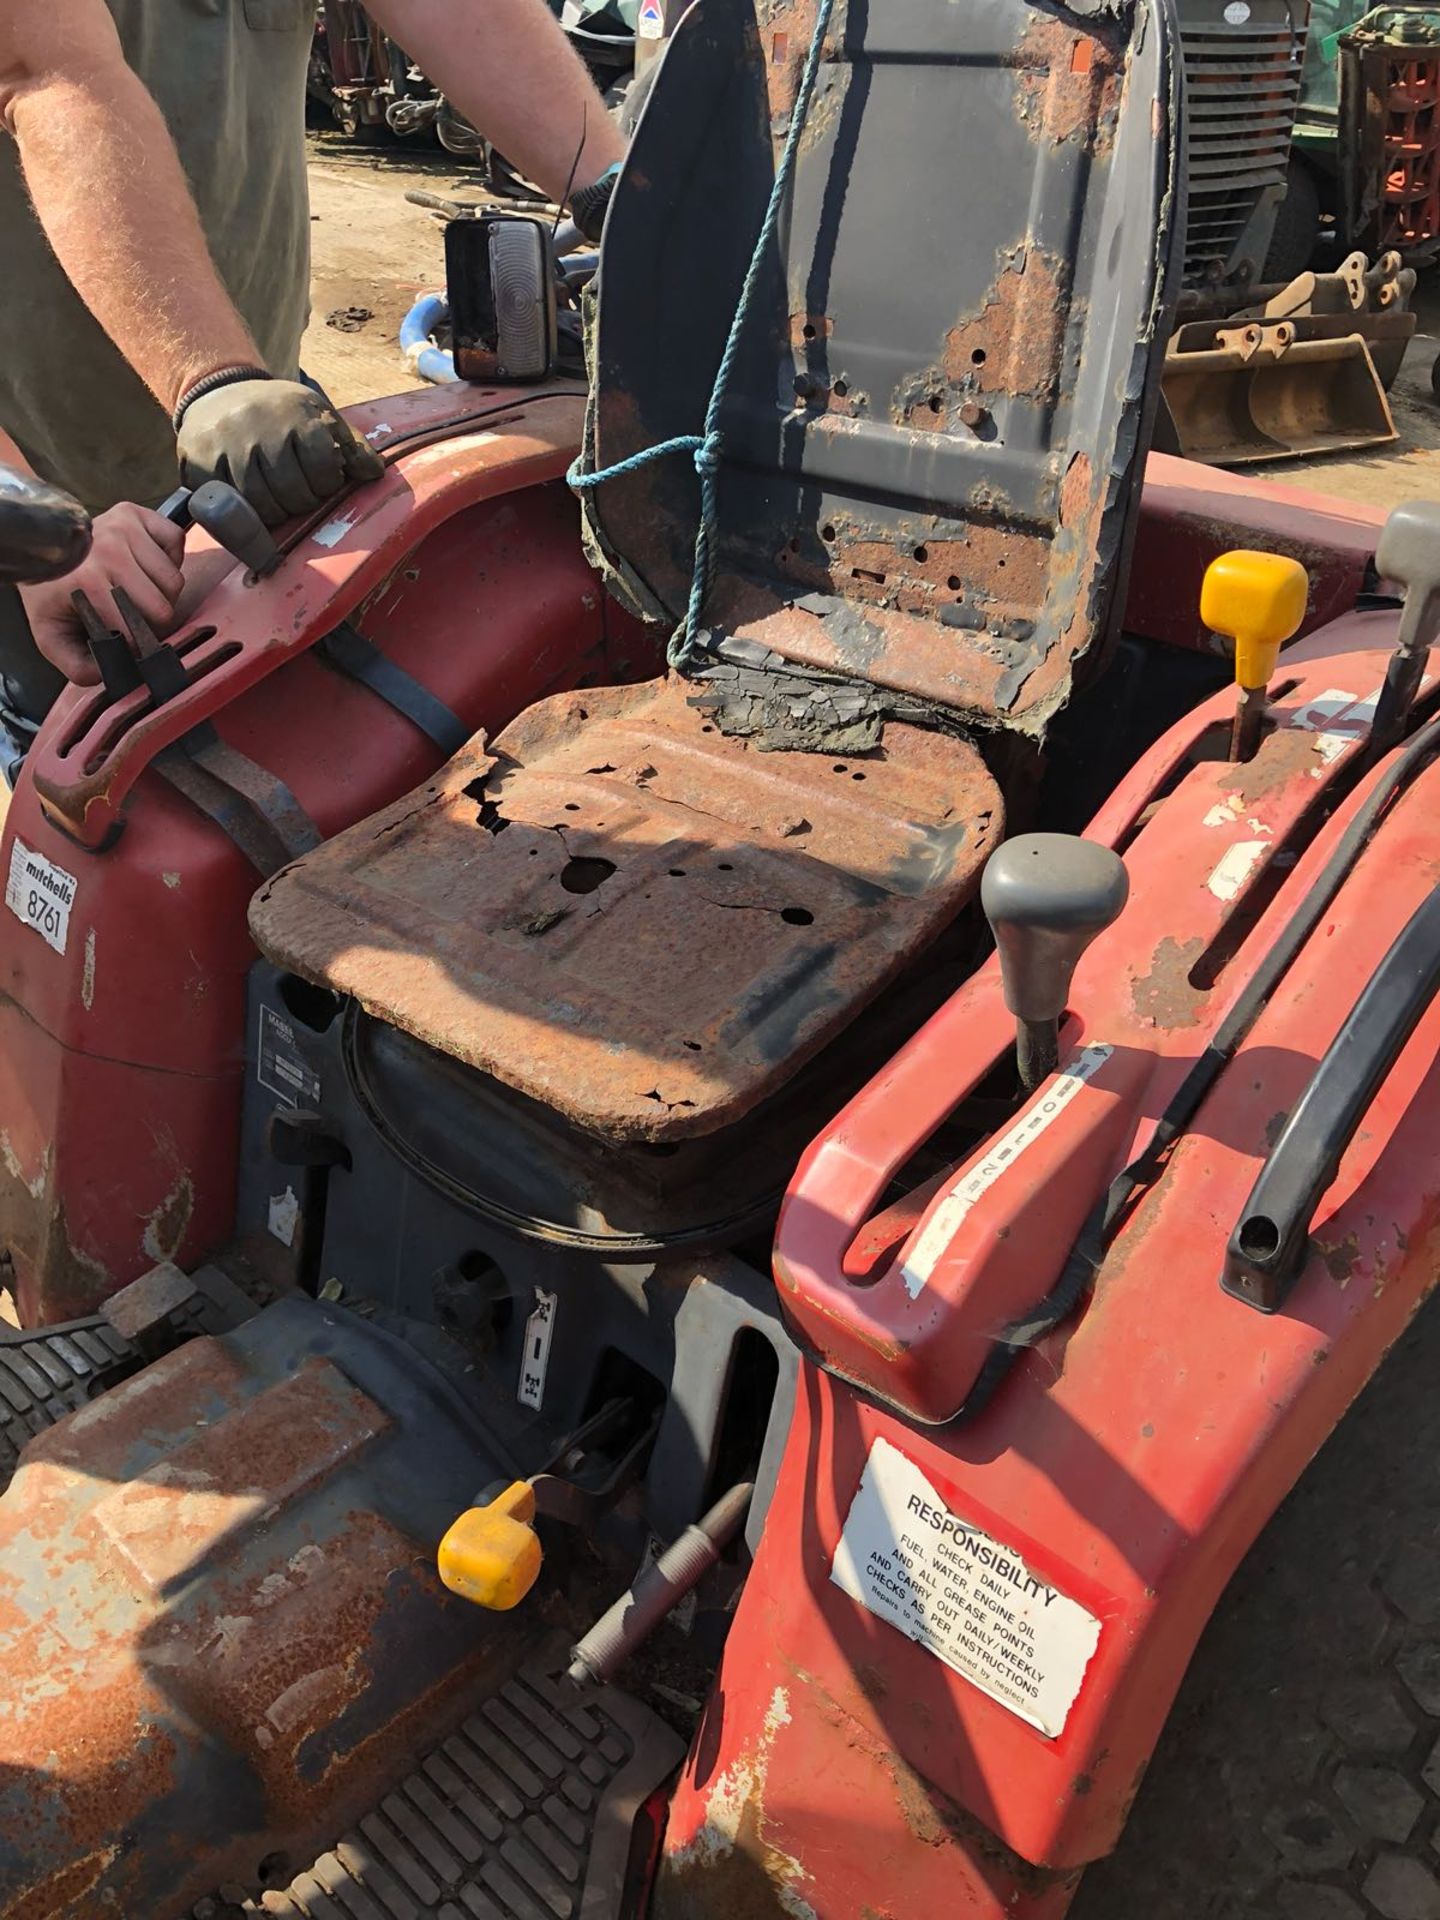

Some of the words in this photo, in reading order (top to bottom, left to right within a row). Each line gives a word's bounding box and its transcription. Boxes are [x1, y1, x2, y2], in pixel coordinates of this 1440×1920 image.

[26, 862, 72, 905] mitchells
[28, 890, 61, 938] 8761
[870, 1551, 892, 1571] AND
[897, 1570, 932, 1600] CARRY
[937, 1600, 960, 1621] OUT
[891, 1549, 914, 1570] AND
[918, 1570, 937, 1589] ALL
[944, 1586, 987, 1624] GREASE
[993, 1622, 1035, 1658] POINTS
[901, 1534, 928, 1562] FUEL,
[932, 1557, 969, 1593] WATER,
[973, 1589, 1016, 1625] ENGINE
[1018, 1621, 1036, 1640] OIL
[907, 1494, 1057, 1608] RESPONSIBILITY
[937, 1543, 974, 1575] CHECK
[980, 1574, 1011, 1600] DAILY
[866, 1564, 905, 1600] CHECKS
[910, 1599, 925, 1615] AS
[930, 1613, 952, 1634] PER
[957, 1633, 1040, 1698] INSTRUCTIONS
[871, 1585, 899, 1611] Repairs
[903, 1609, 911, 1619] to
[914, 1619, 945, 1645] machine
[949, 1645, 978, 1670] caused
[980, 1668, 991, 1680] by
[994, 1680, 1025, 1705] neglect
